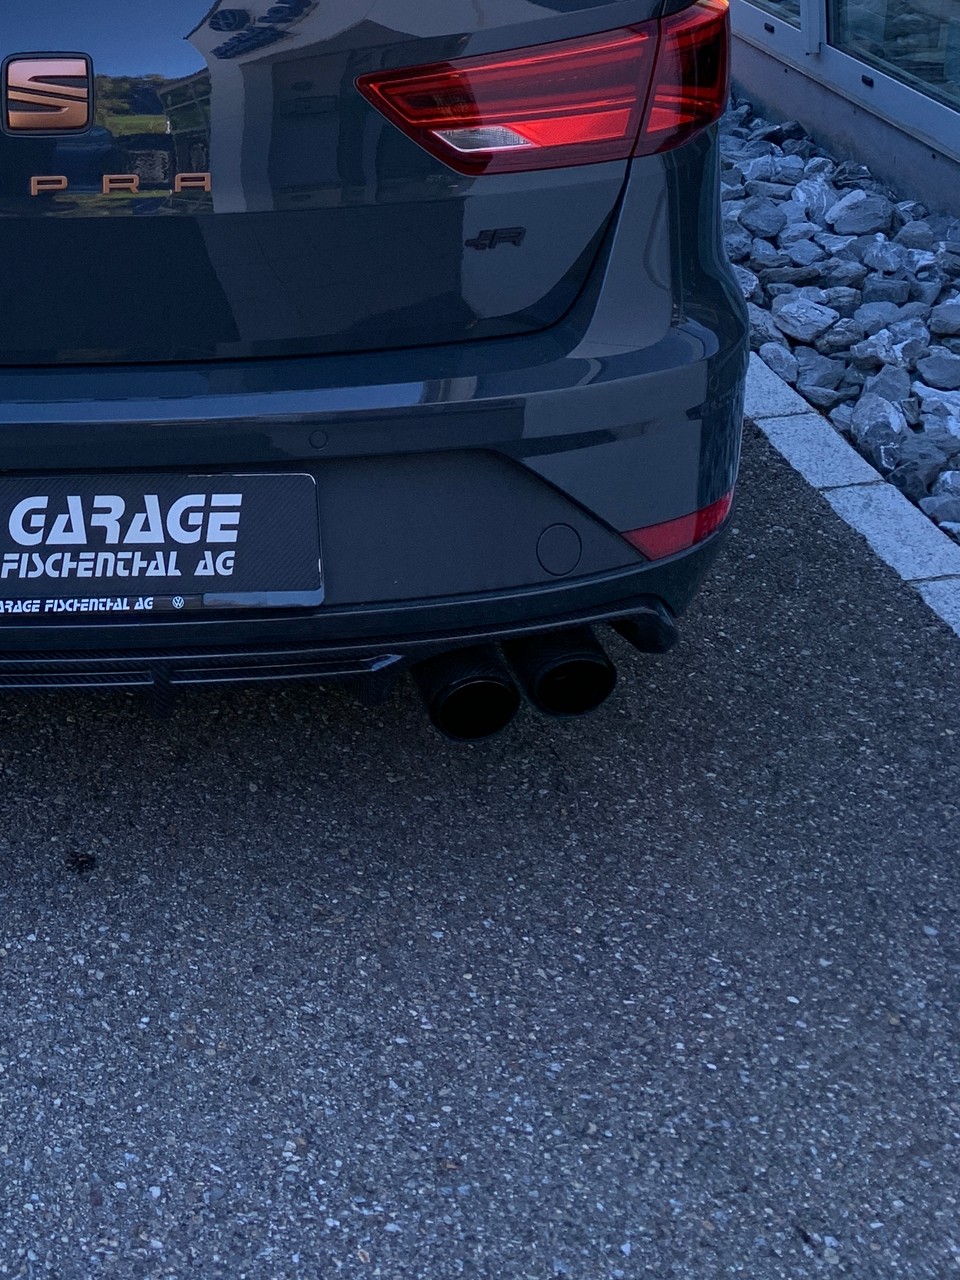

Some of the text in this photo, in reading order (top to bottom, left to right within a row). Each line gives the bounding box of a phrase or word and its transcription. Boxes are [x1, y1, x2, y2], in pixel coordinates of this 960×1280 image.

[8, 493, 243, 546] GARAGE
[0, 550, 236, 579] FISCHENTHAL AG
[44, 597, 130, 612] FISCHENTHAL
[134, 596, 154, 610] AG
